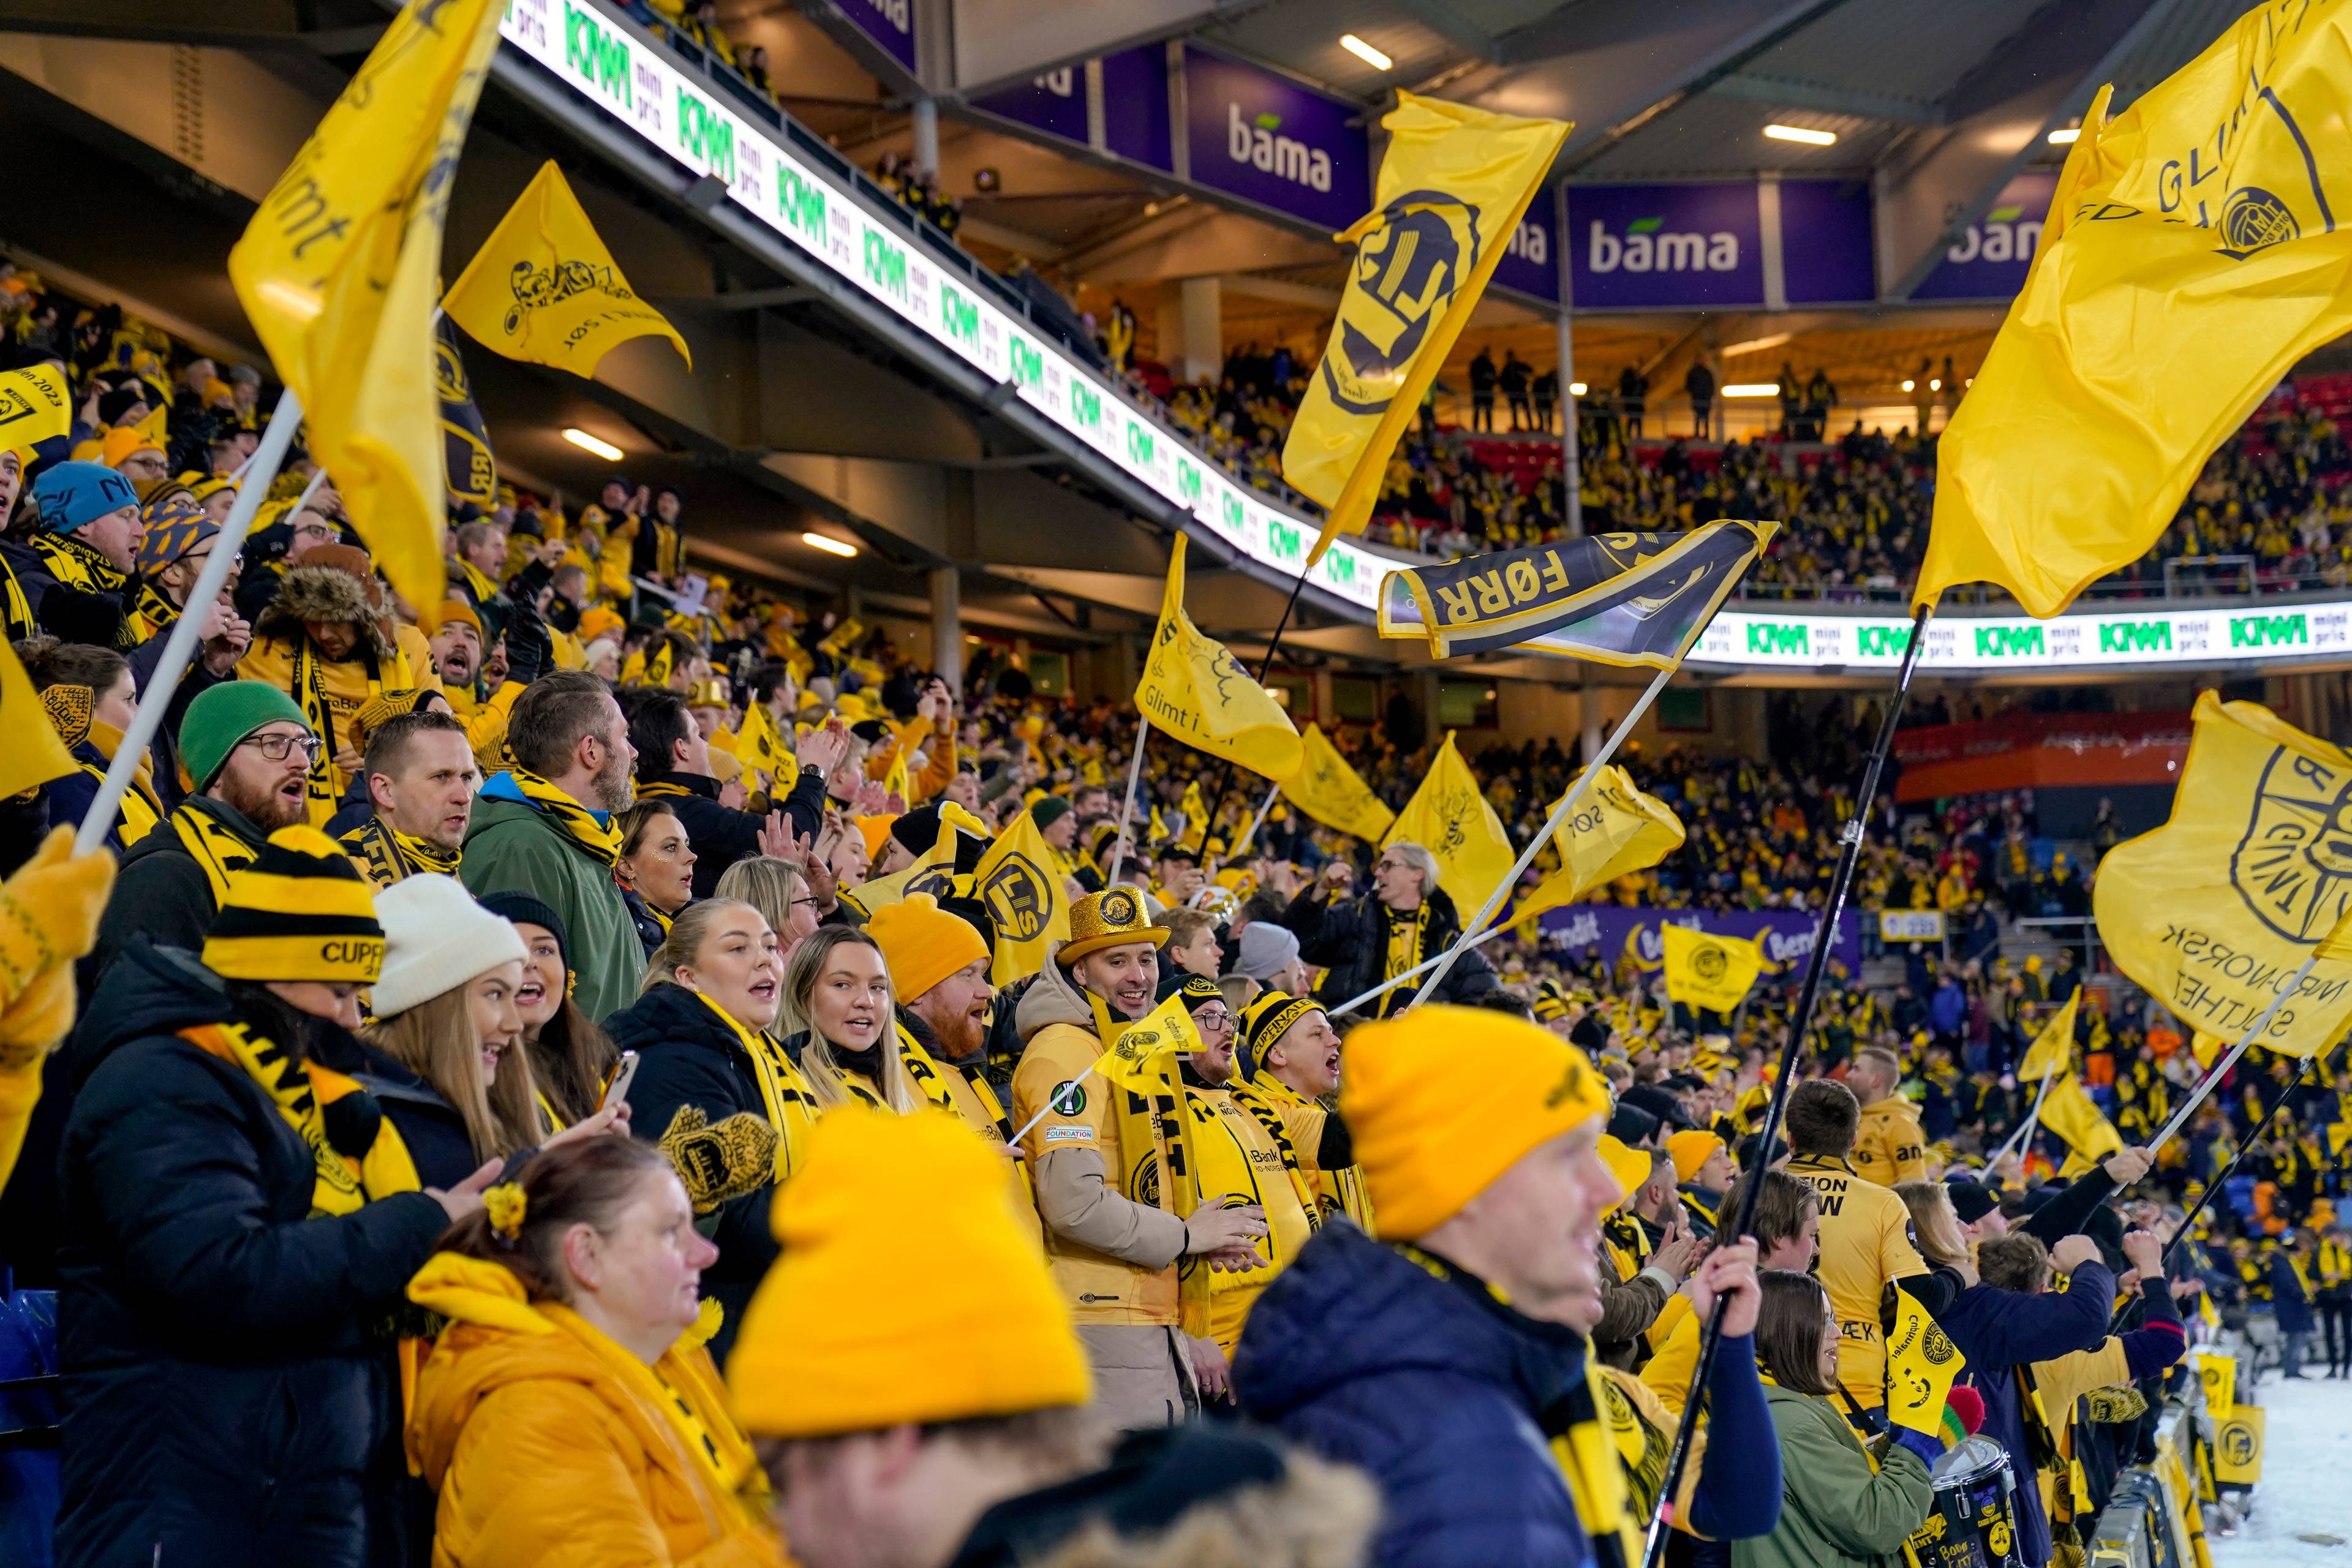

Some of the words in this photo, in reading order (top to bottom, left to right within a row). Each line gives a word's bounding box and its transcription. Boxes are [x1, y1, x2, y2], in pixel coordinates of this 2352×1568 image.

[564, 0, 631, 110] KIWI
[637, 62, 662, 100] mini
[677, 85, 734, 184] KIWI
[1227, 102, 1332, 192] bama
[740, 140, 761, 172] mini
[777, 159, 827, 249] KIWI
[1589, 219, 1740, 274] bama
[863, 222, 908, 304] KIWI
[32, 377, 63, 408] 2023
[1436, 549, 1570, 626] FØRR
[1815, 626, 1841, 641] mini
[1929, 628, 1956, 642] mini
[2051, 625, 2081, 639] mini
[2178, 620, 2210, 635] mini
[2230, 614, 2308, 648] KIWI
[2313, 612, 2348, 628] mini
[1746, 622, 1809, 654] KIWI
[1857, 626, 1915, 657] KIW
[1975, 625, 2045, 657] KIWI
[2098, 620, 2173, 653] KIWI
[1145, 685, 1188, 728] Glimt
[1192, 713, 1200, 732] i
[1269, 1011, 1300, 1041] 2020
